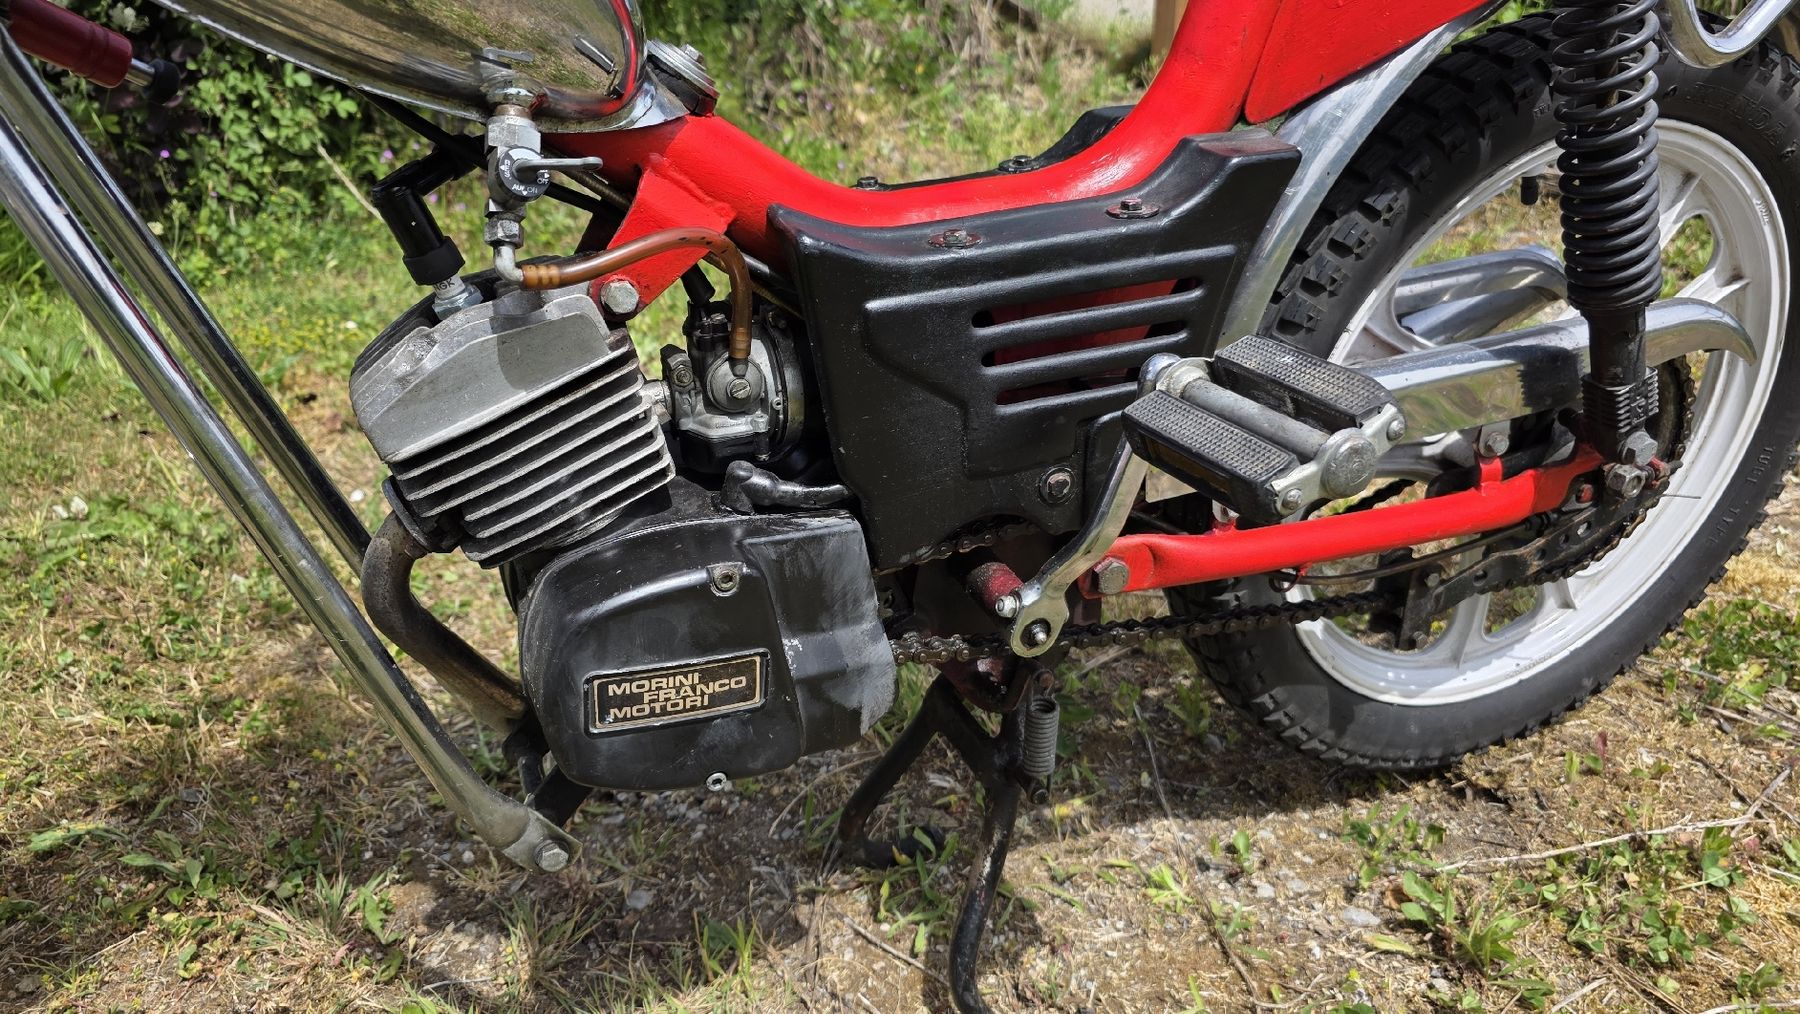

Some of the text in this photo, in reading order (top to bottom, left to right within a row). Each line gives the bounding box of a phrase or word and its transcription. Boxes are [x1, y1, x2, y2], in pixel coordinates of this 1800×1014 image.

[608, 672, 700, 697] MORINI
[643, 676, 747, 704] FRANCO
[609, 694, 709, 720] MOTORI
